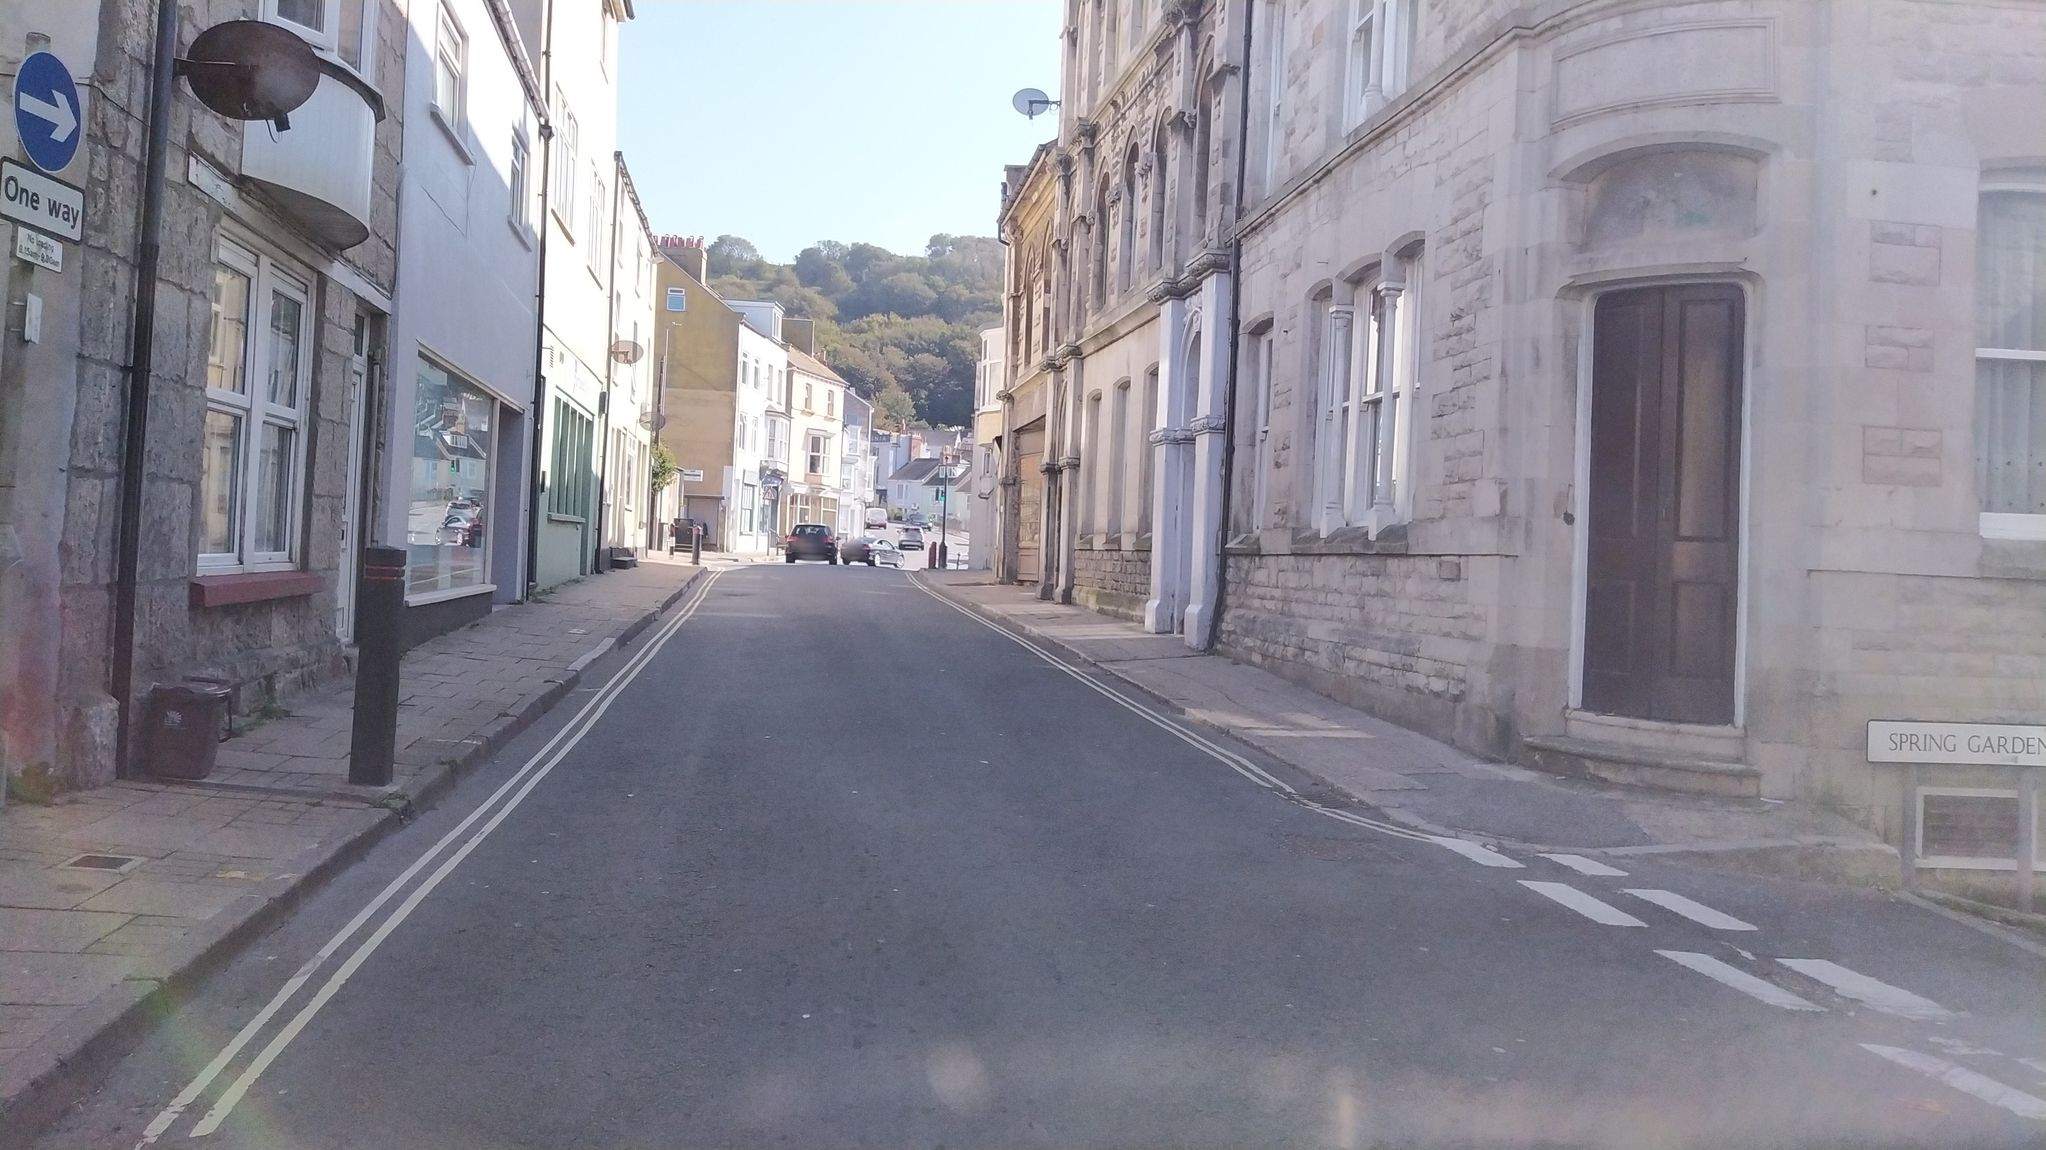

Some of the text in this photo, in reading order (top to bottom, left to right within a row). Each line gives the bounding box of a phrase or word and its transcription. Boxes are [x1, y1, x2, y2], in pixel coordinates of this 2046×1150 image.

[4, 175, 80, 230] One way
[1888, 733, 1957, 752] SPRING
